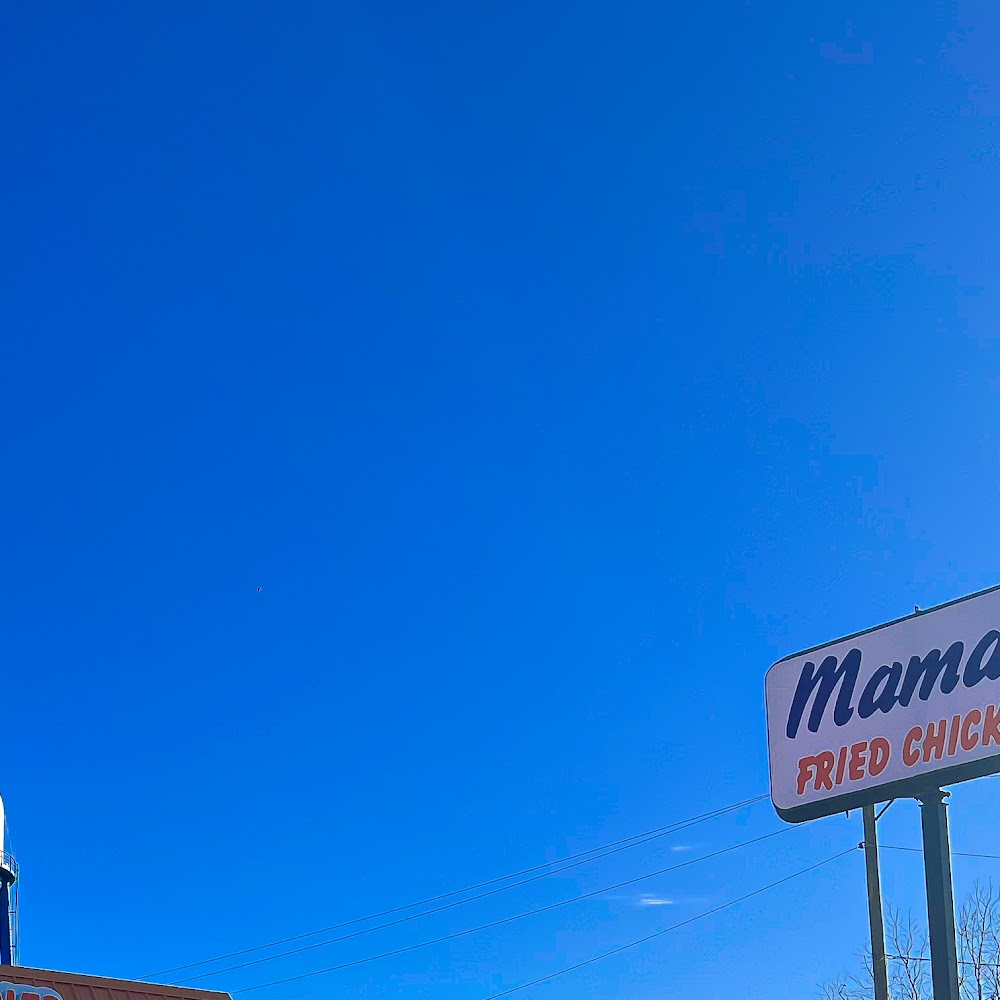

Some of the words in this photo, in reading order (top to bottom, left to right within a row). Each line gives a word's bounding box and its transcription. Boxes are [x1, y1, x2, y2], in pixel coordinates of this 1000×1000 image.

[786, 629, 1000, 739] Mama
[796, 737, 890, 795] FRIED
[902, 704, 1000, 767] CHICK
